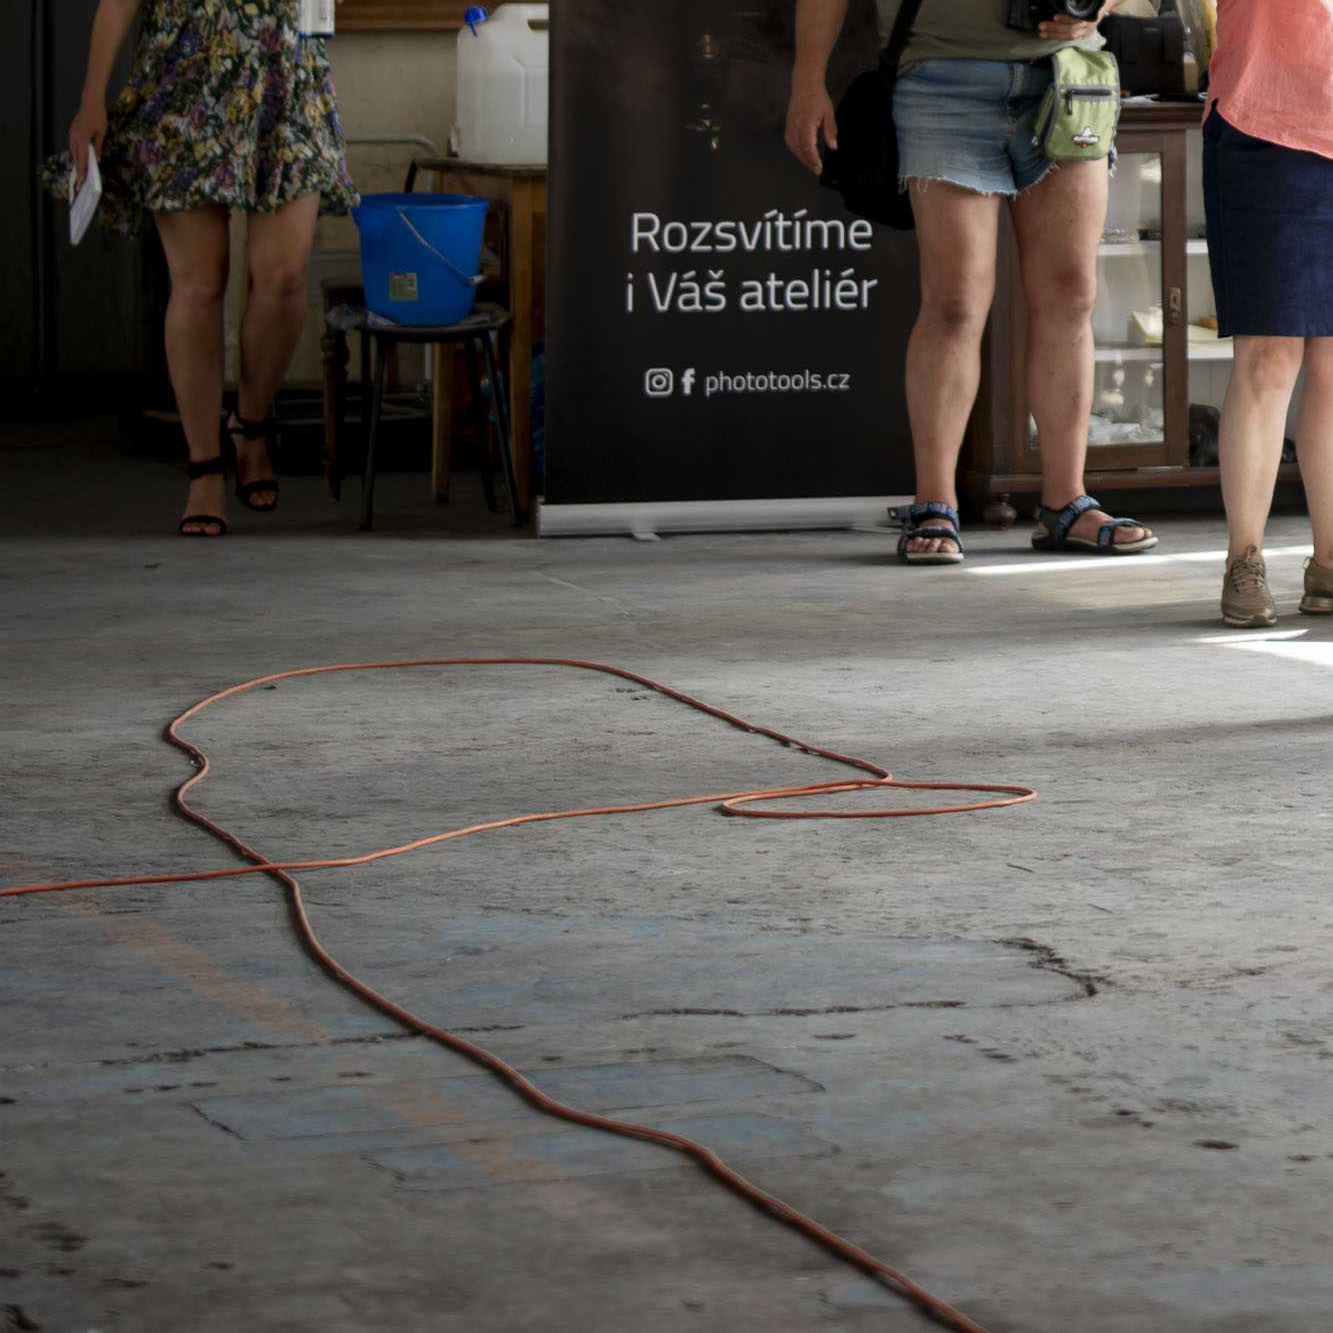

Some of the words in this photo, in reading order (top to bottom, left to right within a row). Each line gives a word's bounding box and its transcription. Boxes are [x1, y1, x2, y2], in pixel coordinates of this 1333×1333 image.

[631, 208, 874, 254] Rozsvítíme
[626, 271, 634, 313] i
[647, 269, 727, 312] Váš
[739, 268, 879, 311] ateliér
[704, 368, 851, 397] phototools.cz
